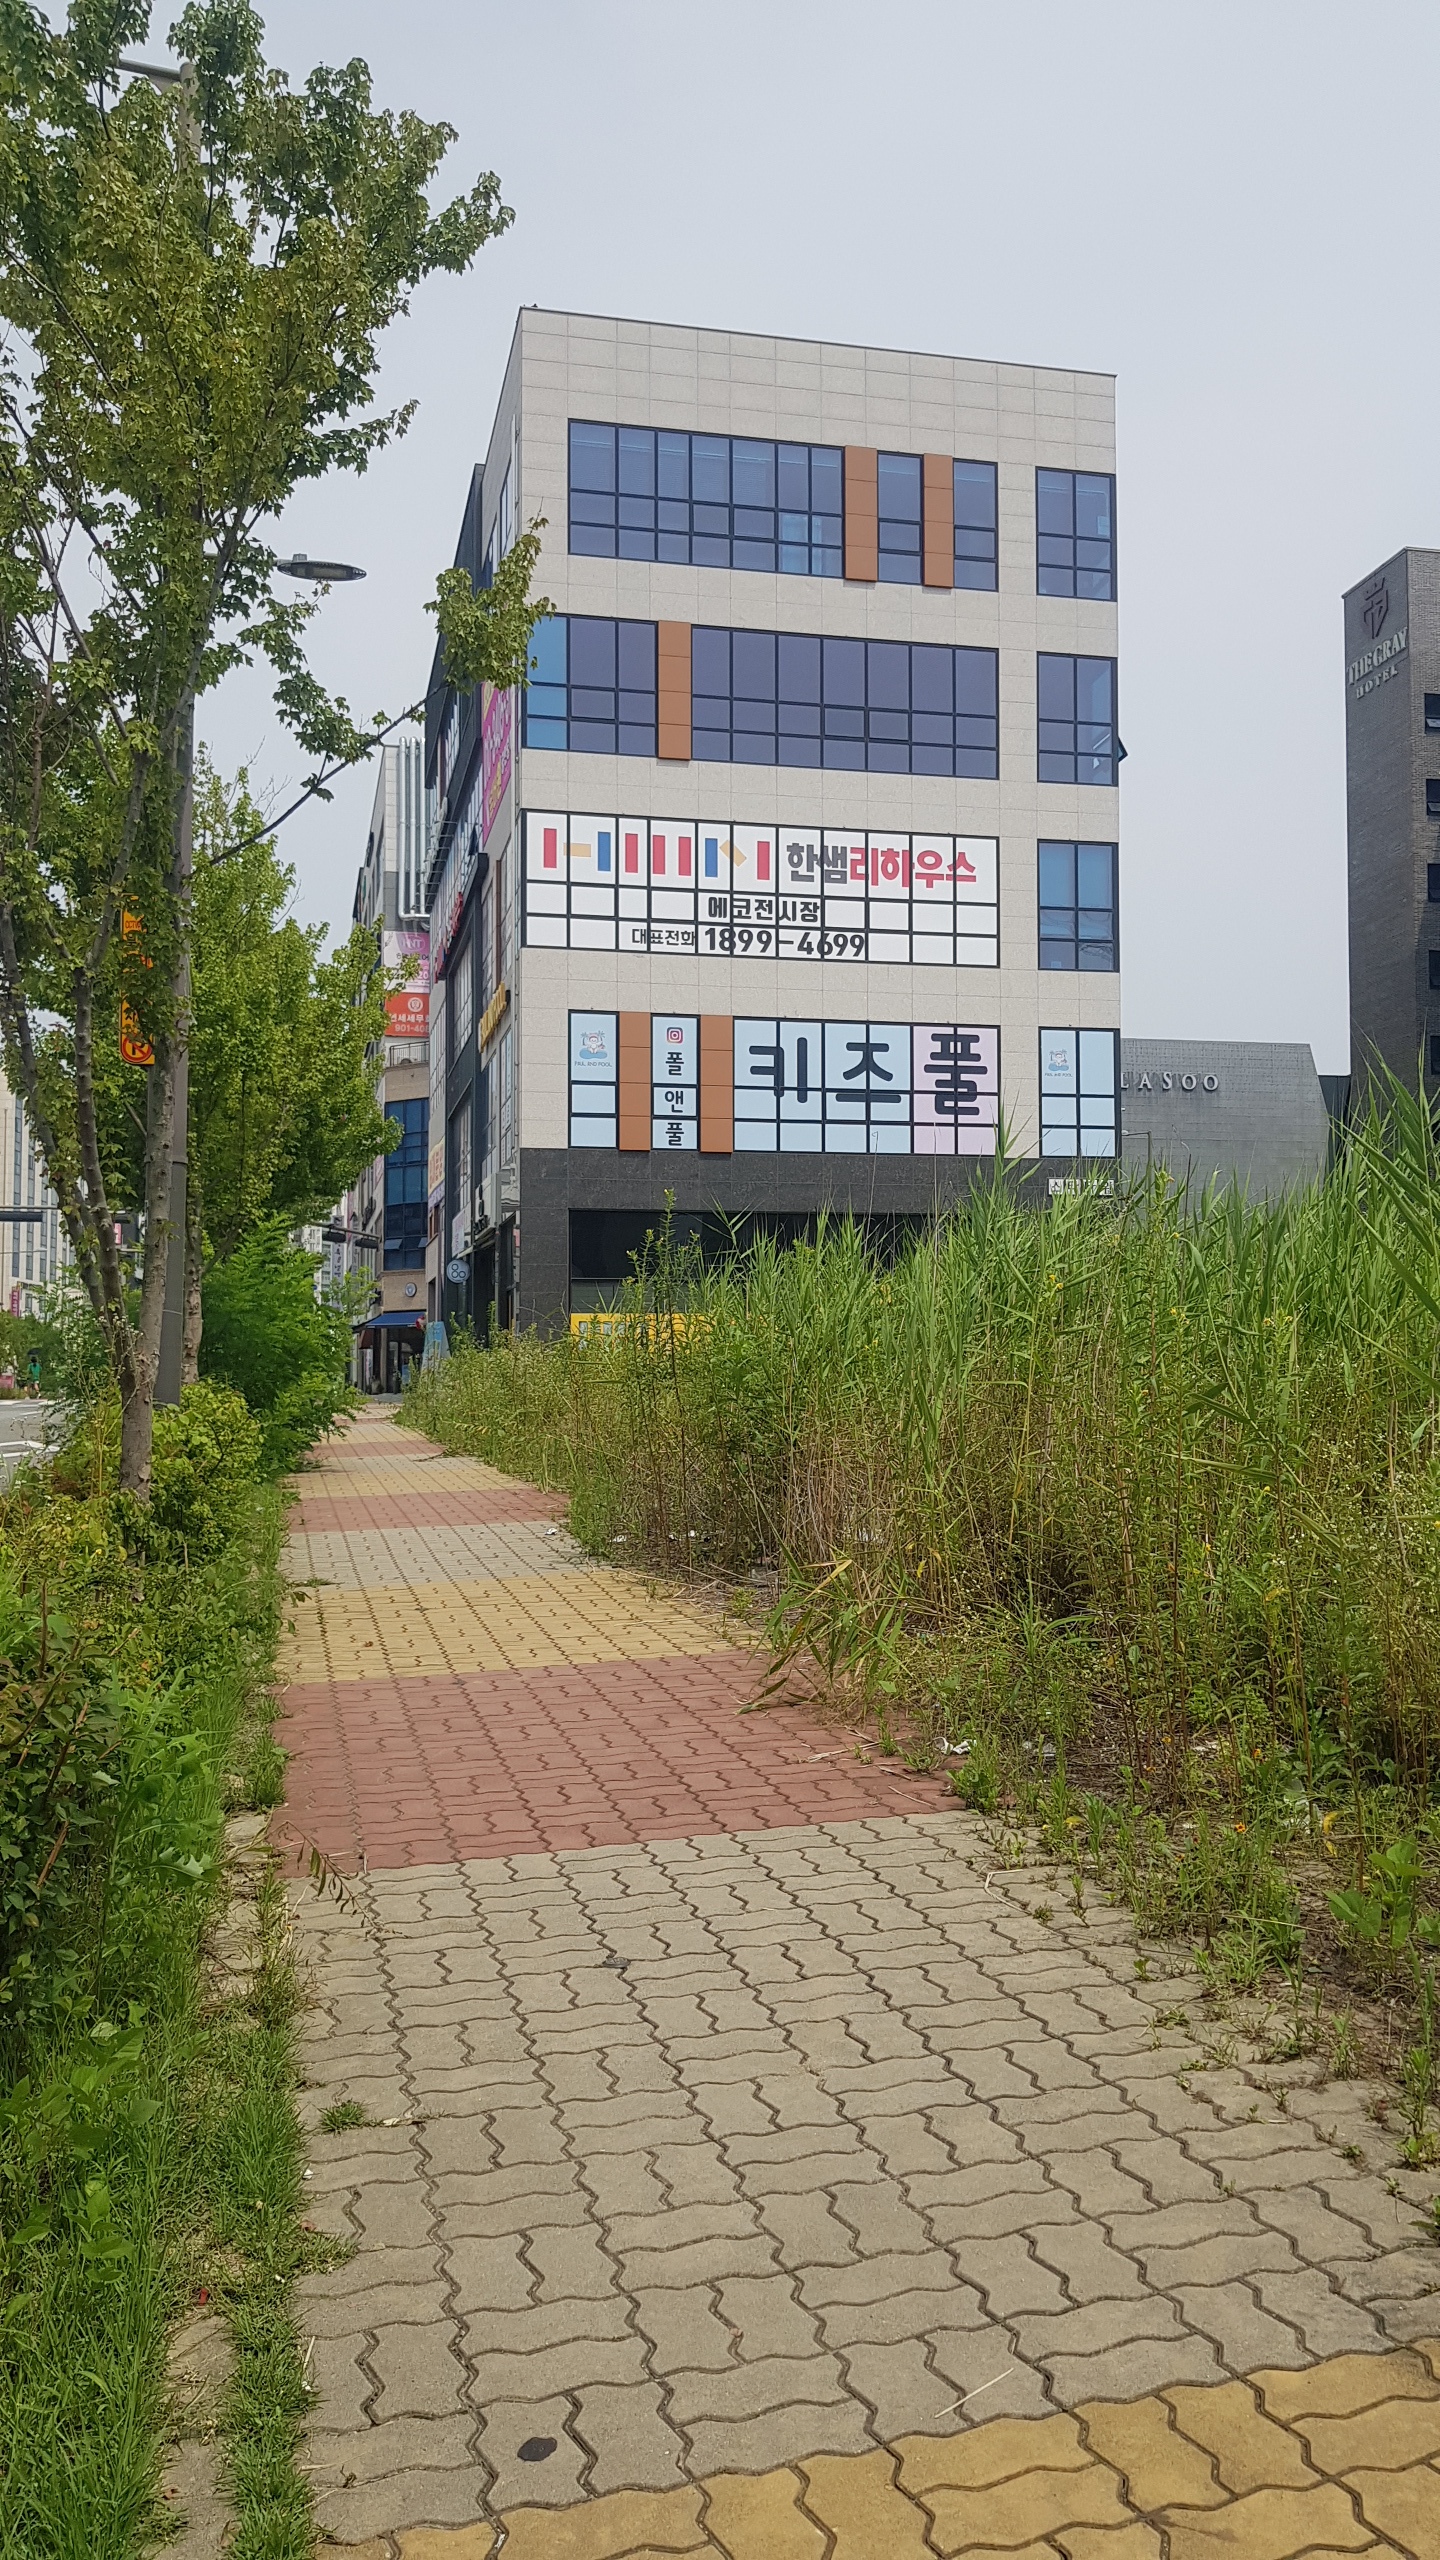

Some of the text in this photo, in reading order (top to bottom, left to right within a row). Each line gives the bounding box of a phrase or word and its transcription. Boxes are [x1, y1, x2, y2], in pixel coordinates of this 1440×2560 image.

[1356, 664, 1399, 699] HOTEL
[708, 896, 820, 923] 에코전시장
[631, 927, 865, 957] 대표전화 1899-4699
[748, 1032, 989, 1116] 키즈풀
